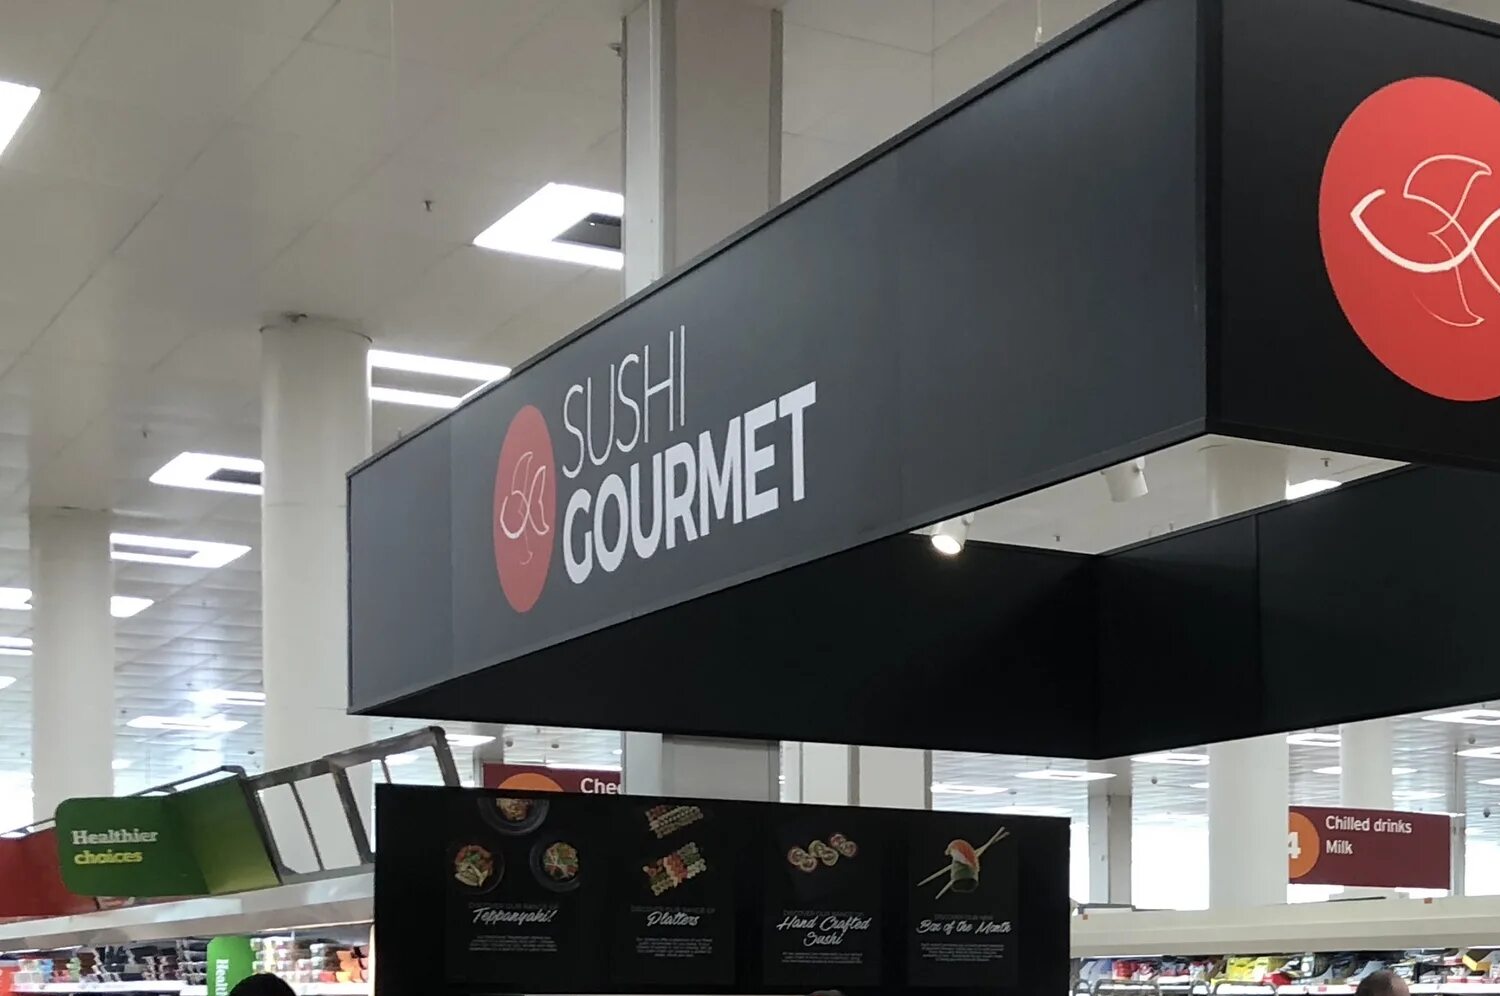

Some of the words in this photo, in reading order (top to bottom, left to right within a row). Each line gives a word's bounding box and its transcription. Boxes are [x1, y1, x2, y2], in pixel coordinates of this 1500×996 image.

[562, 324, 685, 479] SUSHI
[562, 380, 817, 584] GOURMET
[1325, 814, 1370, 833] Chilled
[1374, 817, 1412, 834] drinks
[71, 828, 159, 845] Healthier
[1326, 839, 1354, 856] Milk
[73, 848, 144, 866] choices
[472, 907, 560, 926] Teppanyaki!
[646, 911, 701, 927] Platters
[776, 915, 816, 931] Hand
[818, 916, 874, 936] Crafted
[916, 919, 941, 934] Box
[943, 920, 953, 935] of
[954, 920, 974, 933] the
[975, 920, 1013, 935] Month
[803, 931, 844, 947] Sushi
